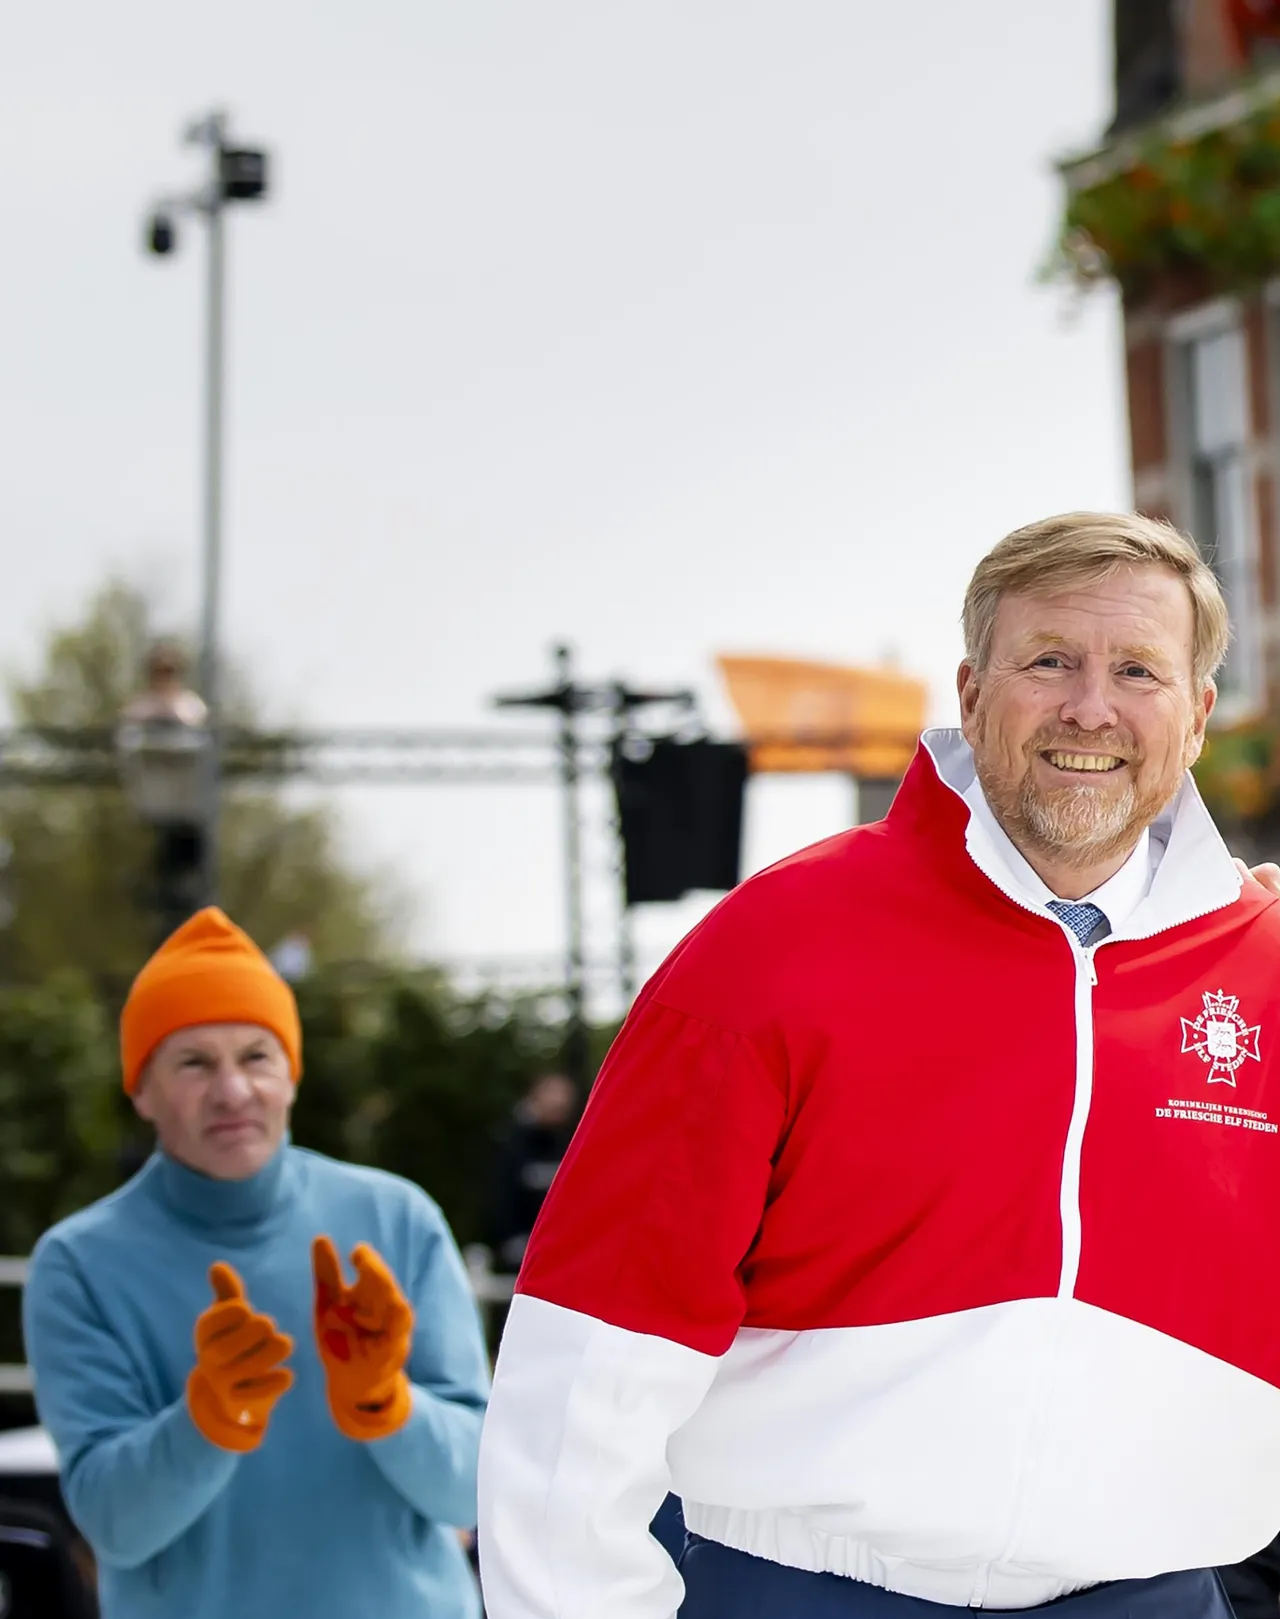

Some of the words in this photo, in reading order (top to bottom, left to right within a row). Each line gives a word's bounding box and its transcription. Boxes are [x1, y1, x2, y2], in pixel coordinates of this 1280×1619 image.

[1193, 1014, 1205, 1031] DE
[1168, 1099, 1222, 1112] KONINKLIJKE
[1155, 1107, 1172, 1118] DE
[1173, 1109, 1223, 1124] FRIESCHE
[1224, 1115, 1242, 1127] ELF
[1242, 1118, 1279, 1134] STEDEN
